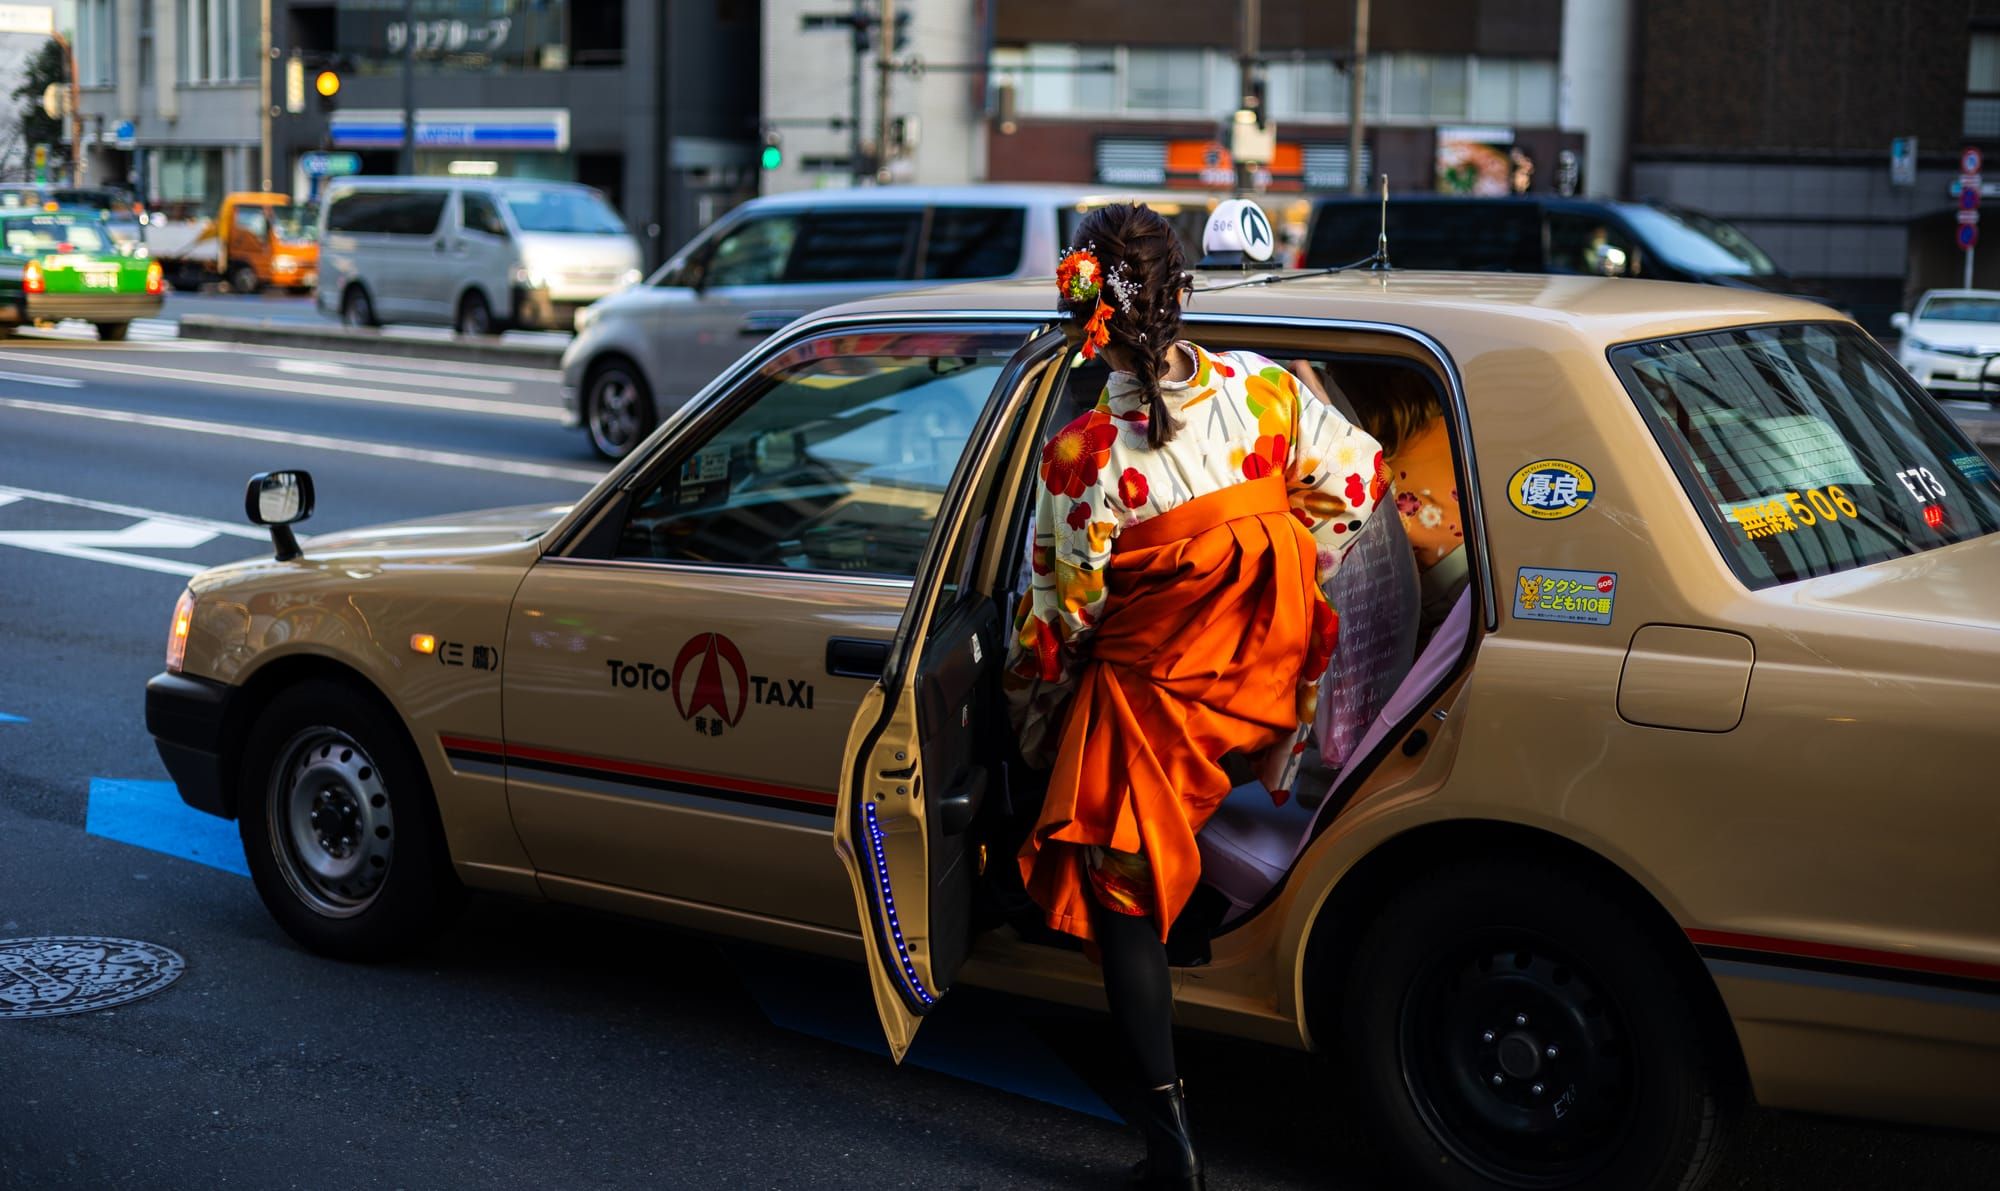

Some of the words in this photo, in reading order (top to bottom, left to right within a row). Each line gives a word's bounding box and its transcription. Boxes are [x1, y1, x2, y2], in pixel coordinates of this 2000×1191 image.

[1213, 220, 1233, 233] 506
[1521, 462, 1551, 477] EXCELLENT
[1551, 462, 1573, 470] SERVICE
[1522, 473, 1579, 507] 優良
[1896, 466, 1947, 503] E73
[1542, 578, 1596, 594] タクシー
[1597, 579, 1613, 589] SOS
[1540, 595, 1611, 614] こども110番
[750, 675, 814, 710] TAXI
